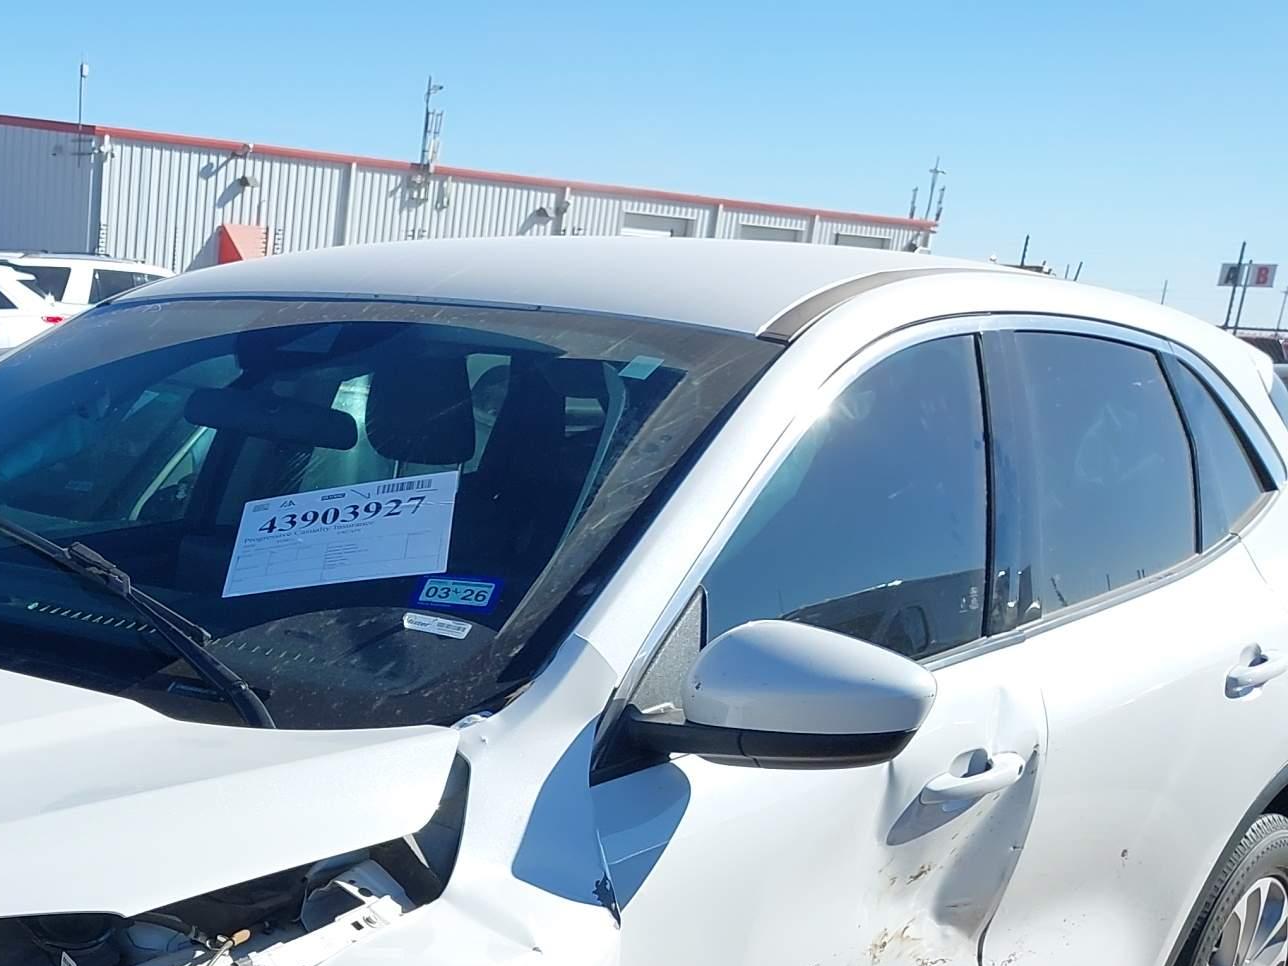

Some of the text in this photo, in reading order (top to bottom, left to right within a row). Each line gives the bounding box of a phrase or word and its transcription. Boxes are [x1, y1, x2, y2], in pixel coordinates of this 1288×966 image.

[1255, 266, 1270, 284] B
[258, 495, 427, 534] 43903927
[425, 586, 489, 602] 03 26
